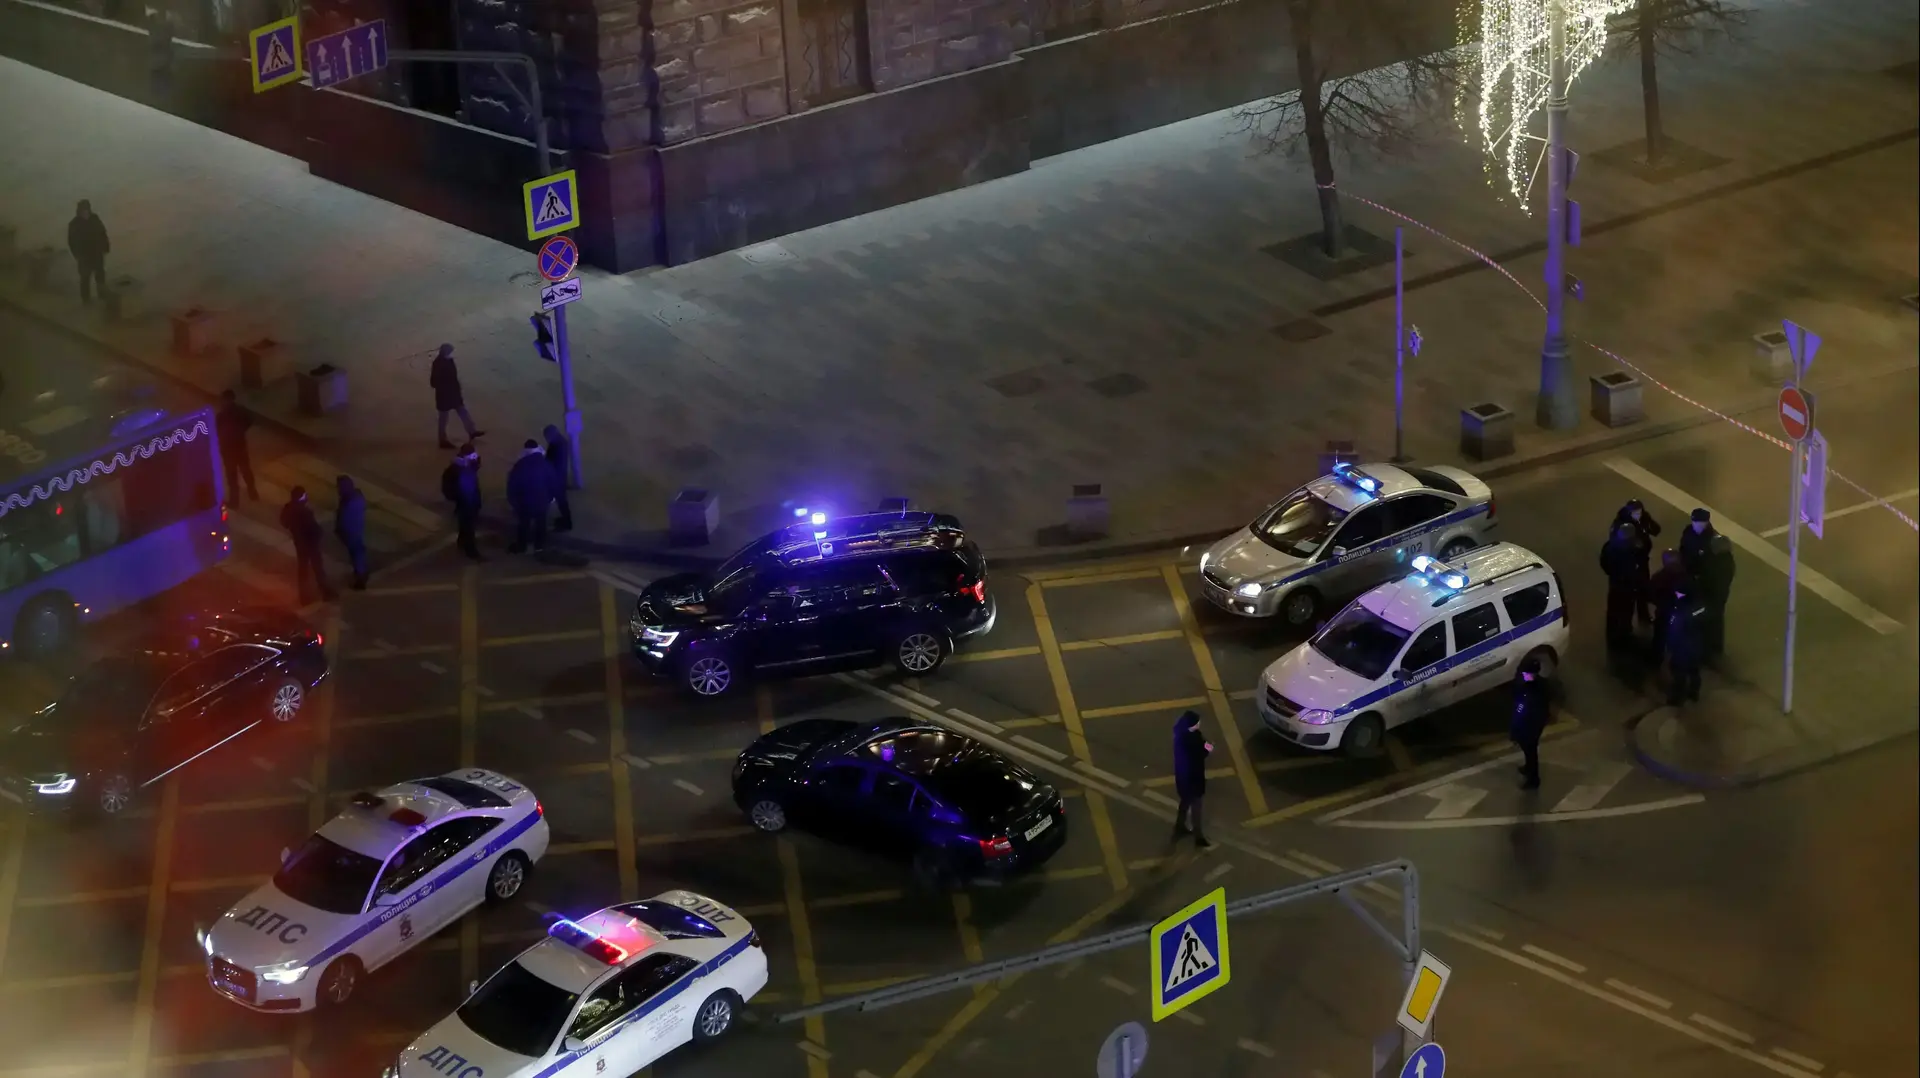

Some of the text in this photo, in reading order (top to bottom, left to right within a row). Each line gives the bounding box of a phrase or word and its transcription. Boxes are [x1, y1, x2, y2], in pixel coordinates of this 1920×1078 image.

[1338, 547, 1371, 563] ПОЛИЦИЯ
[1403, 667, 1438, 687] ПОЛИЦИЯ
[380, 894, 417, 922] ПОЛИЦИЯ
[234, 905, 309, 945] ДПС
